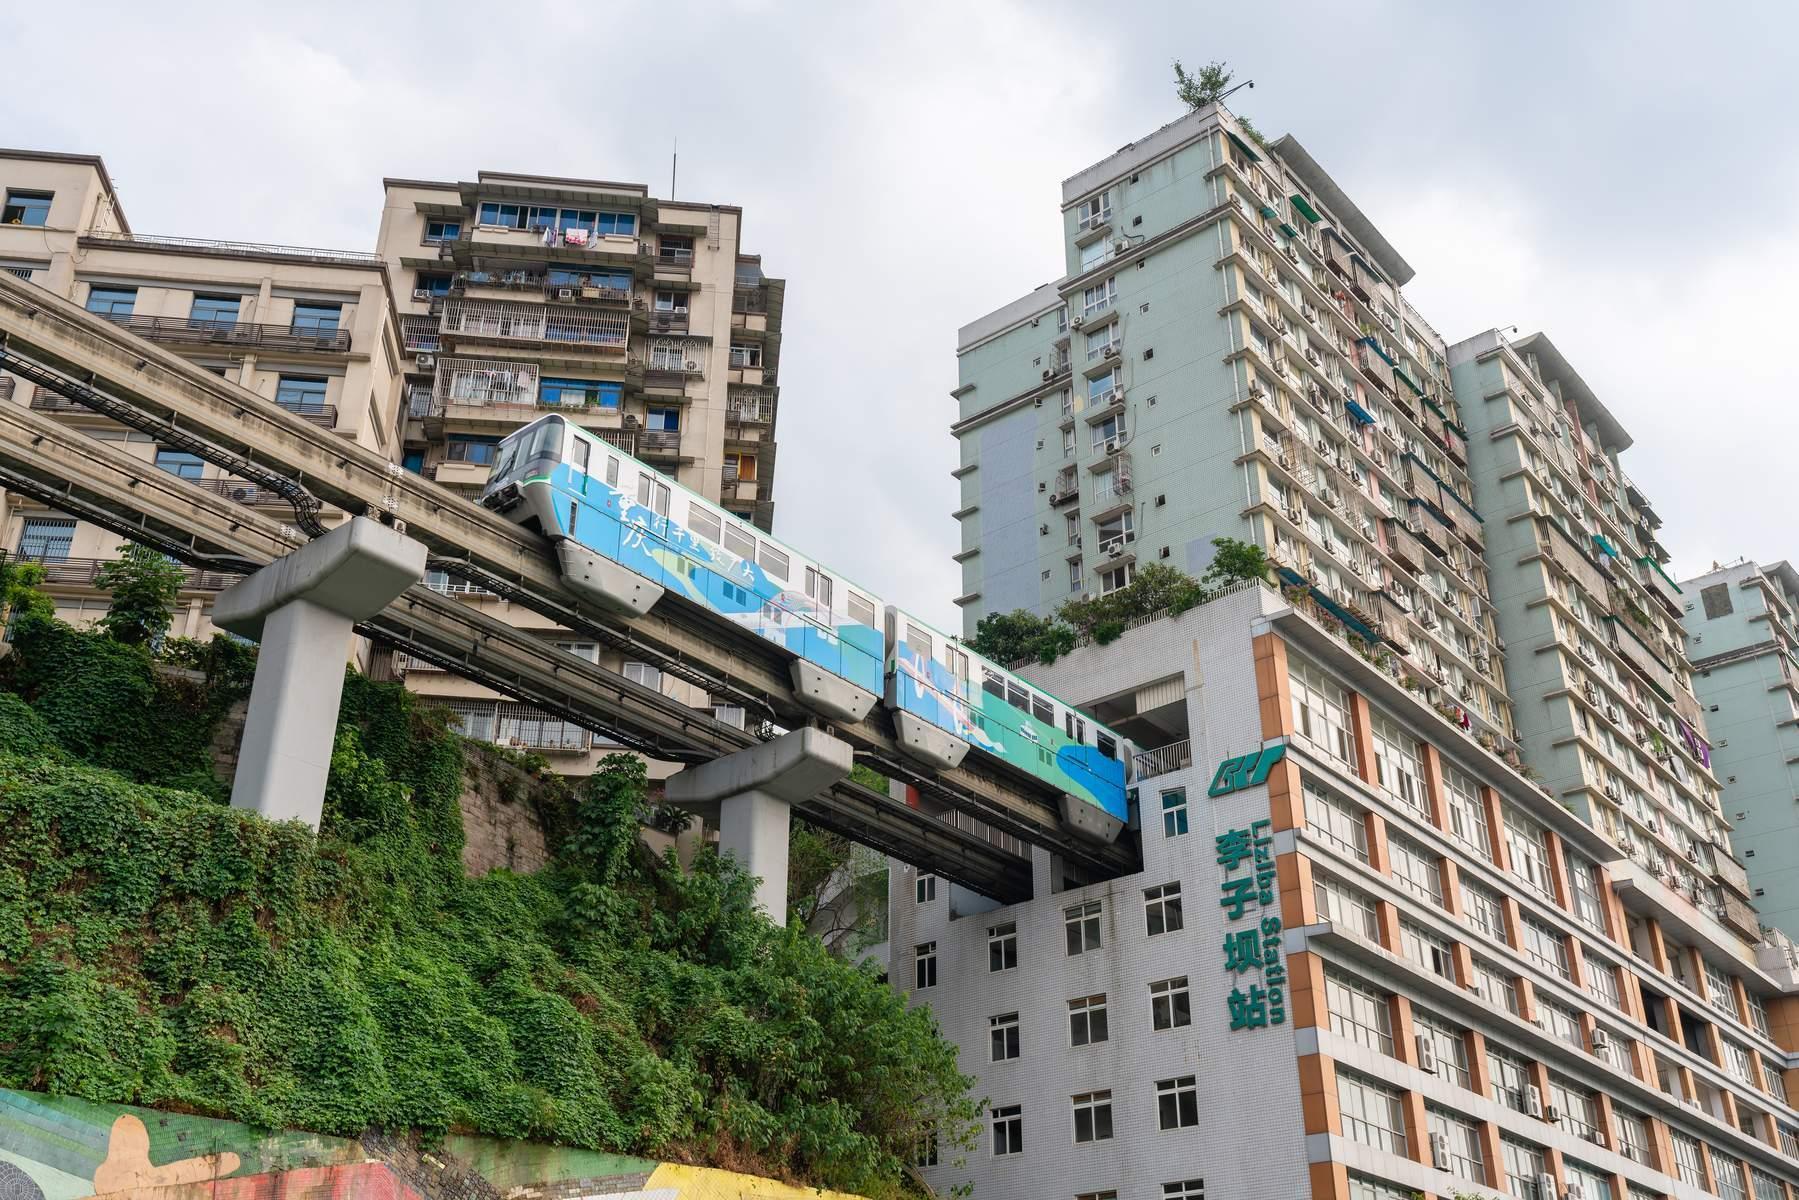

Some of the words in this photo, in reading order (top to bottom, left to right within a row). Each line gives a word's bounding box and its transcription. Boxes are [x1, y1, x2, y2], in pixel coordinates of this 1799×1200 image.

[1251, 818, 1276, 906] Liziba
[1215, 829, 1267, 1031] 李子坝站
[1261, 916, 1287, 1025] Station
